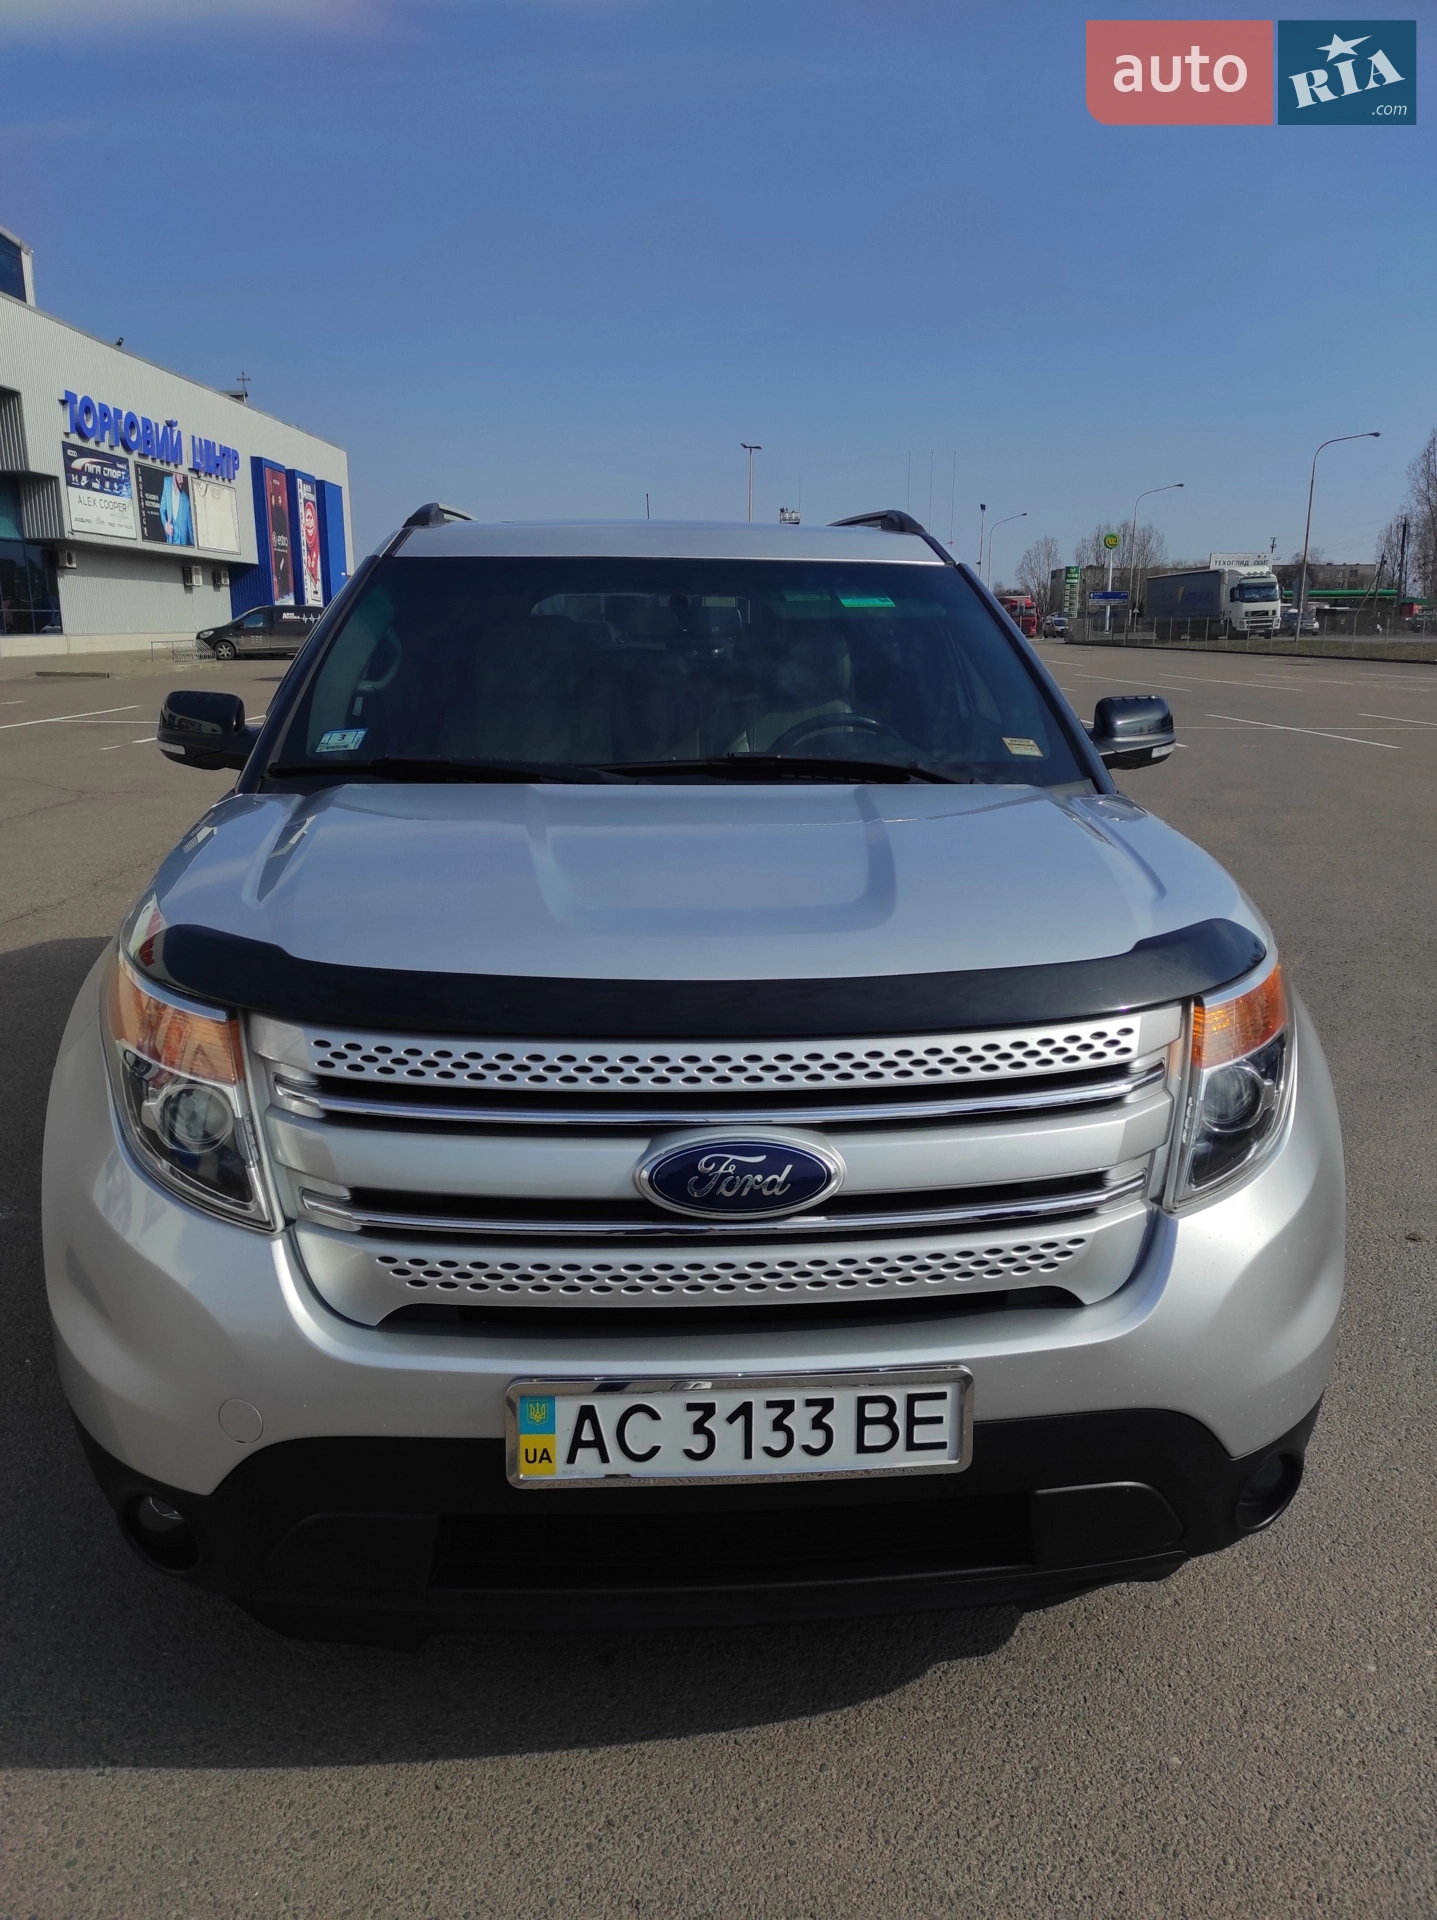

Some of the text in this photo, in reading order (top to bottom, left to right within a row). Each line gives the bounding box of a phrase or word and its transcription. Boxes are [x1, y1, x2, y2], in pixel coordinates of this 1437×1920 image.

[64, 389, 240, 480] ТОРГОВИЙ ЦЕНТР
[77, 494, 127, 513] ALEX COOPER
[686, 1153, 793, 1198] Ford
[565, 1390, 948, 1465] AC 3133 BE
[524, 1447, 553, 1464] UA
